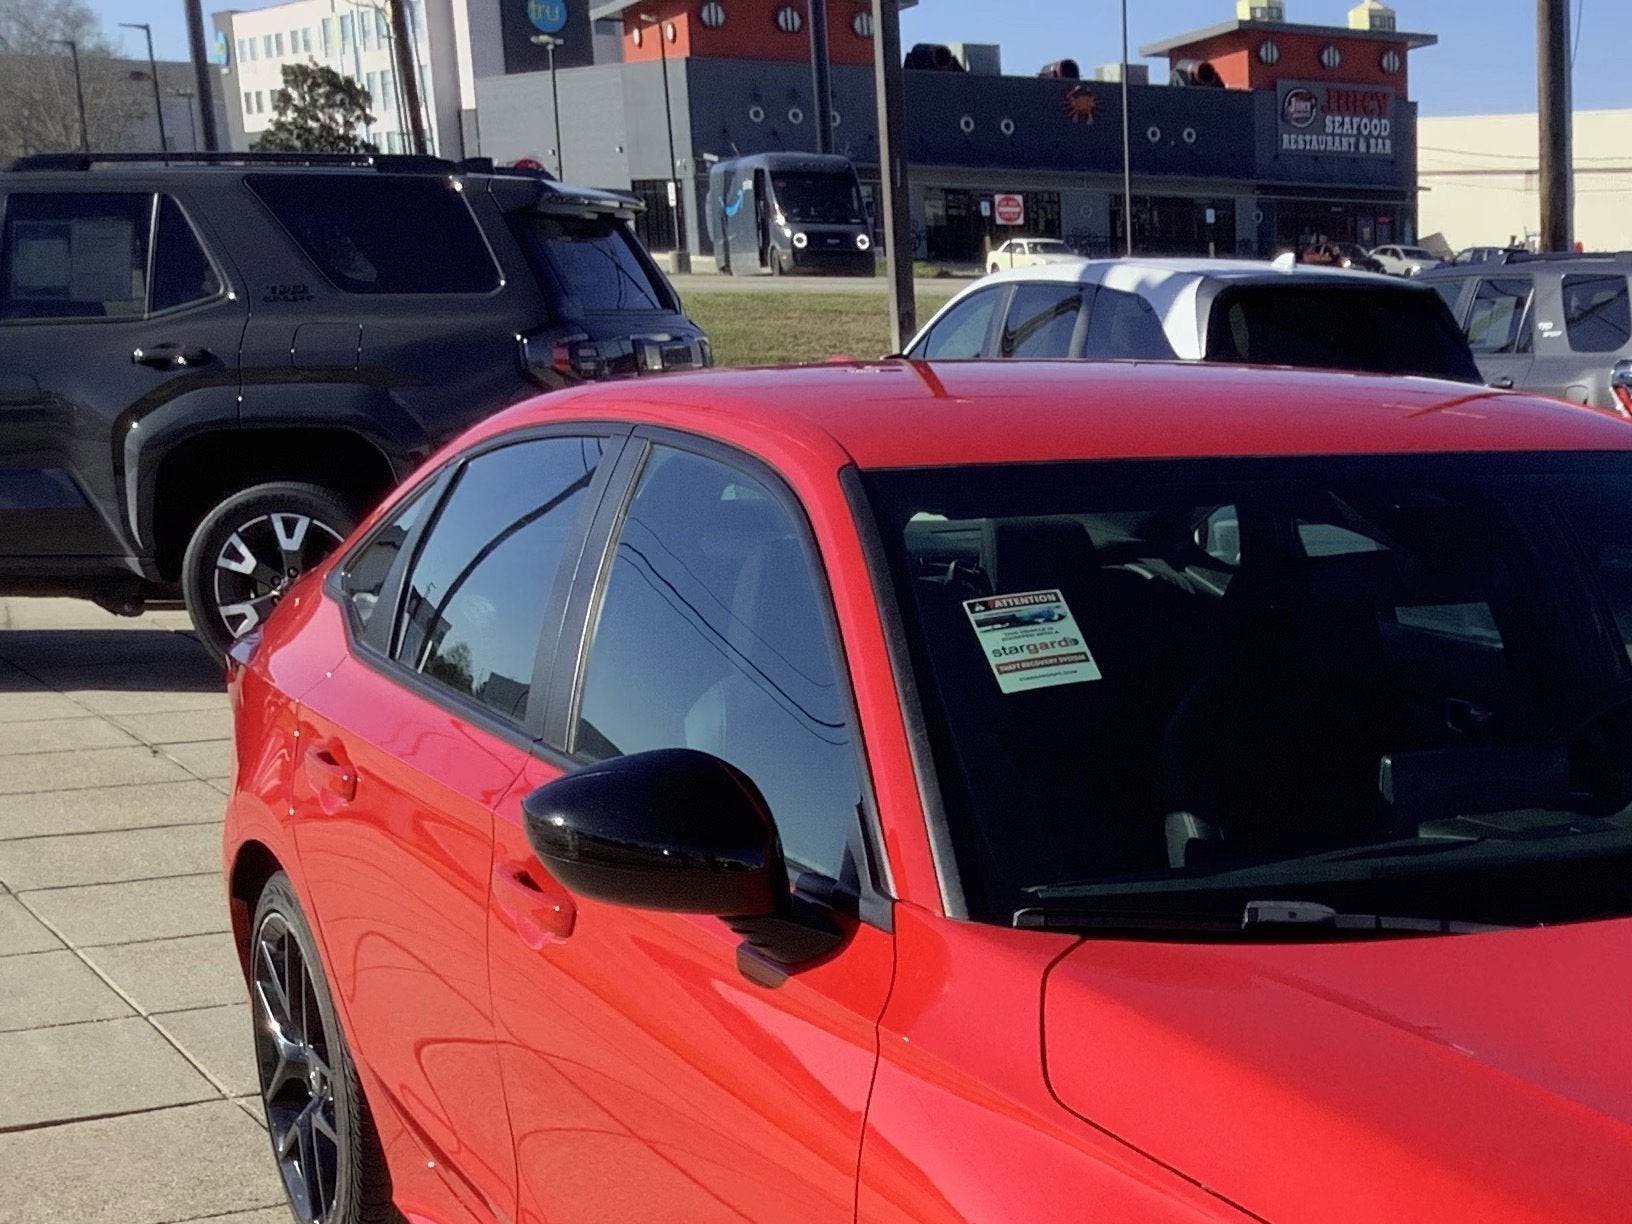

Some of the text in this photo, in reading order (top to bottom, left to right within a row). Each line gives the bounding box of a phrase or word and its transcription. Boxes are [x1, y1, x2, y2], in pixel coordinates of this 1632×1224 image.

[1325, 115, 1390, 136] SEAFOOD
[1282, 133, 1356, 152] RESTAURANT
[1369, 138, 1391, 154] BAR
[994, 593, 1056, 609] ATTENTION
